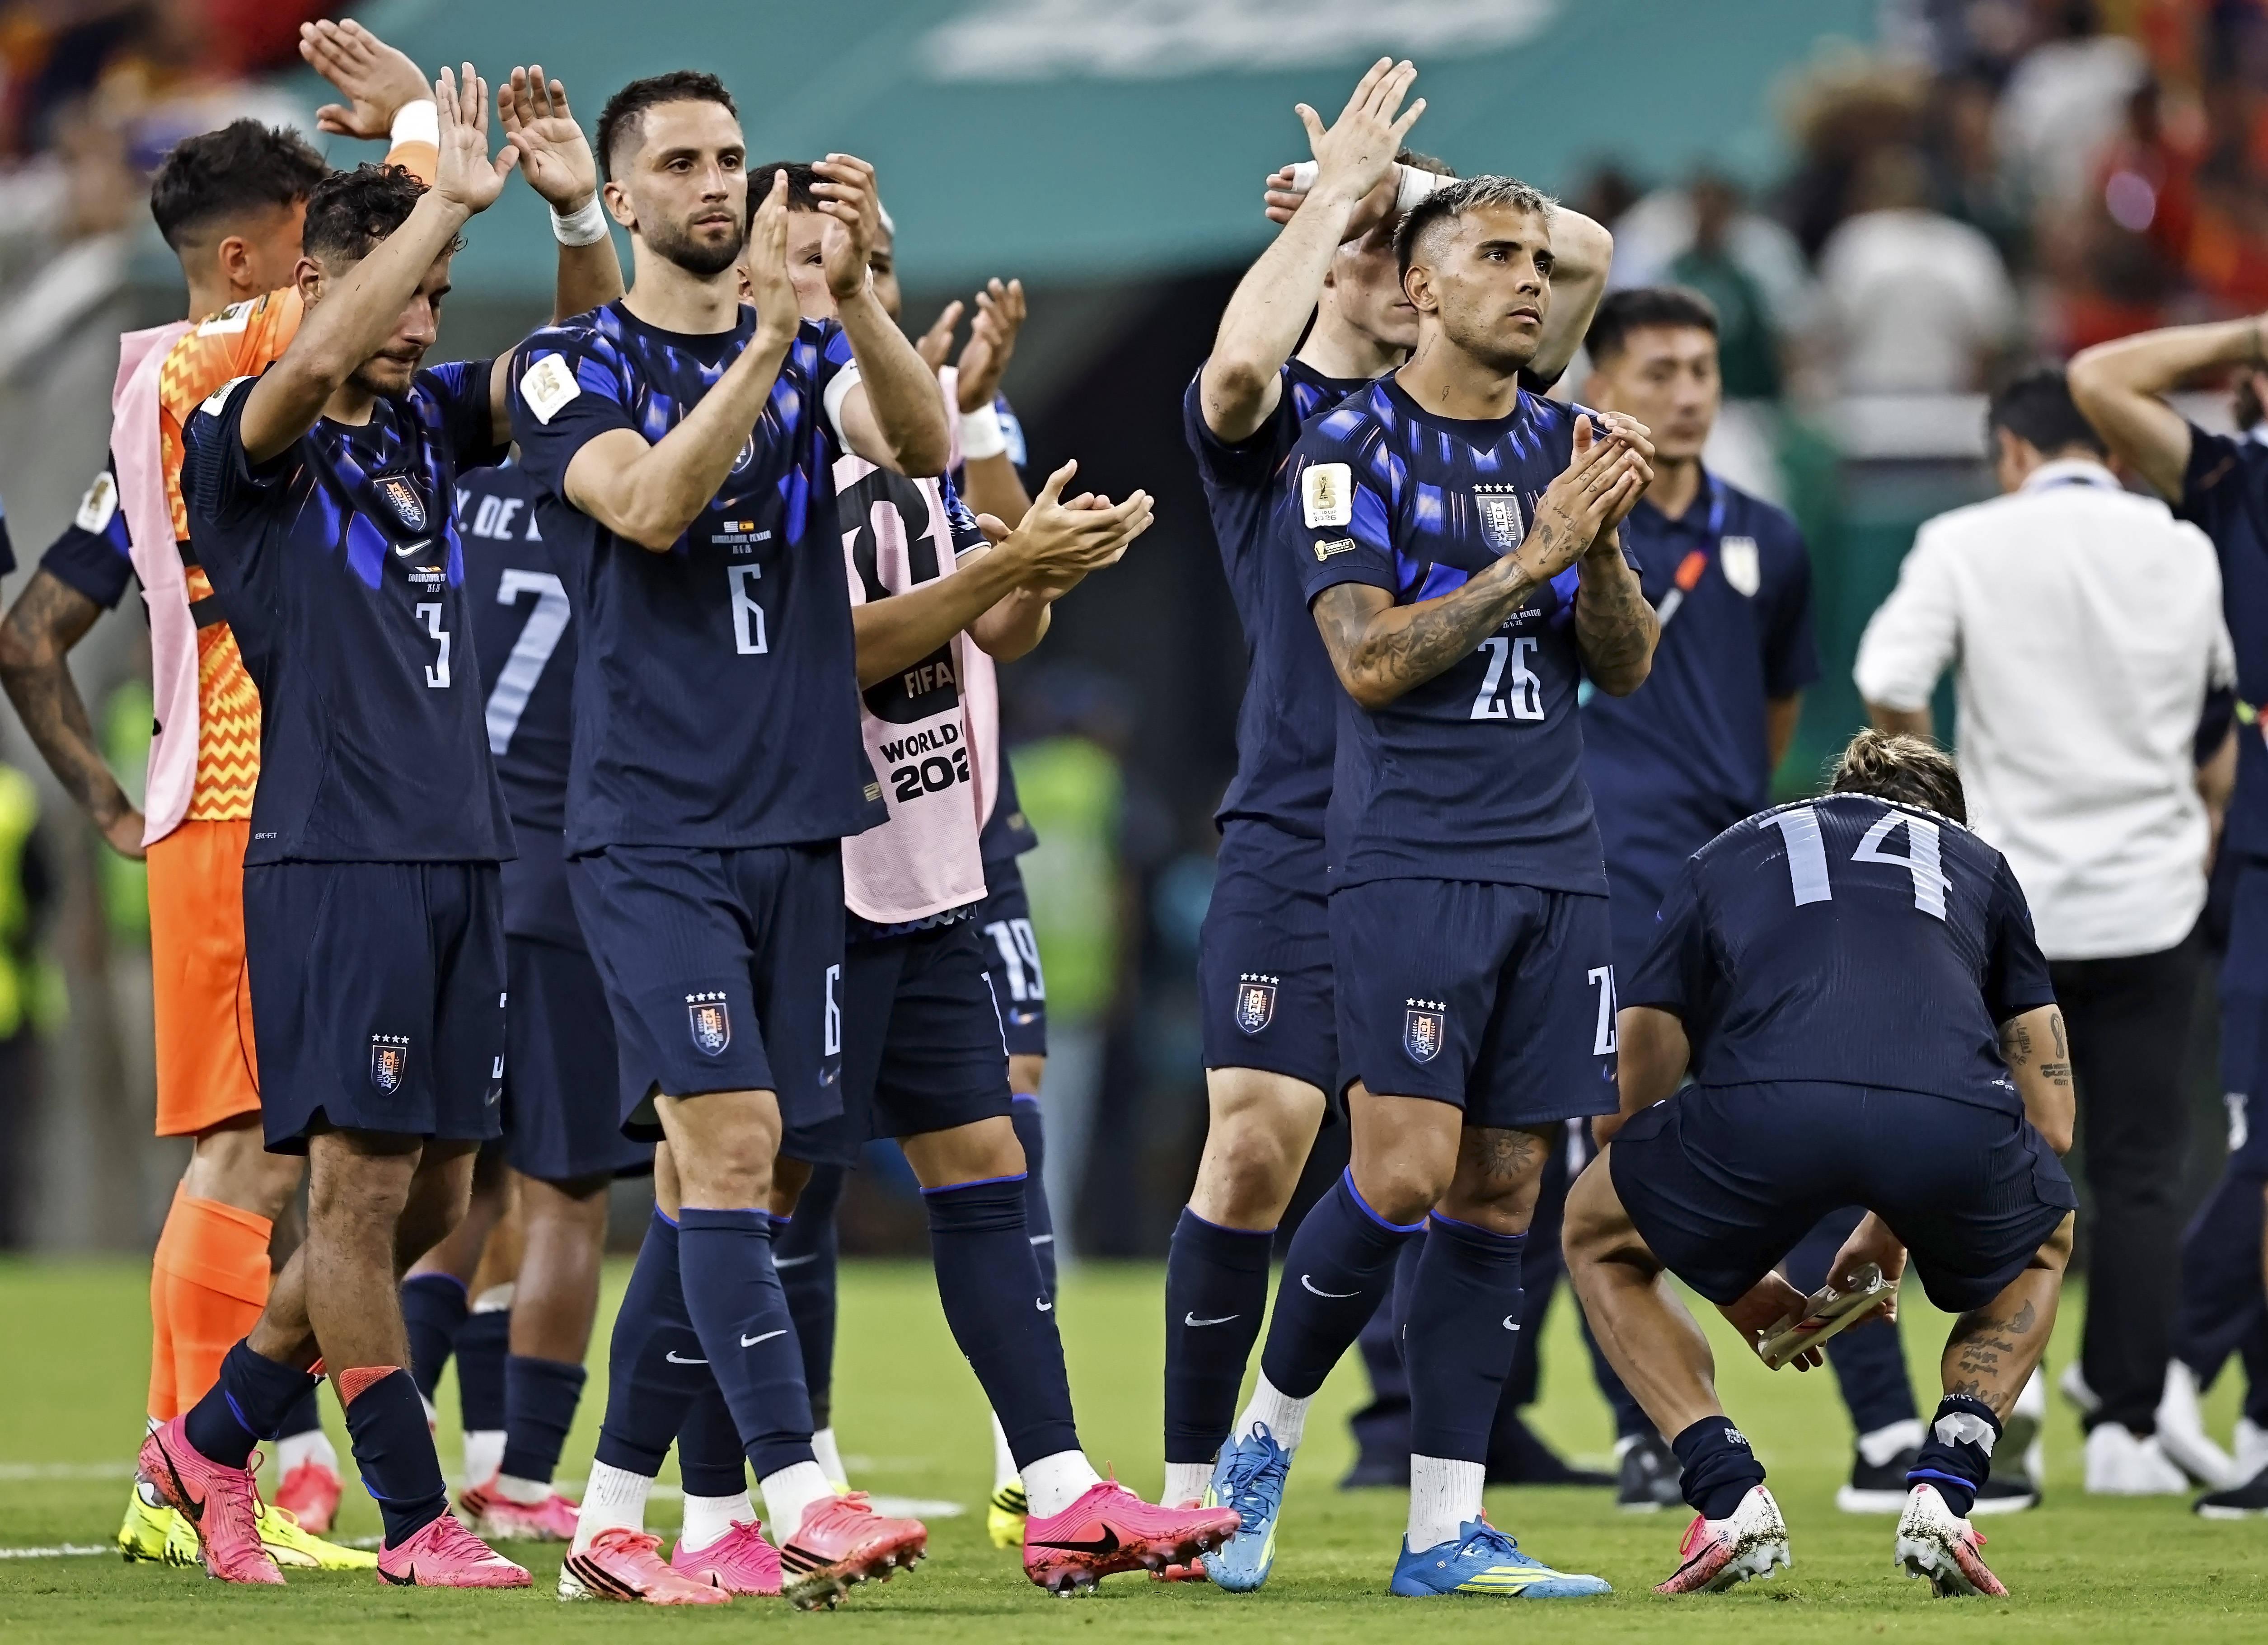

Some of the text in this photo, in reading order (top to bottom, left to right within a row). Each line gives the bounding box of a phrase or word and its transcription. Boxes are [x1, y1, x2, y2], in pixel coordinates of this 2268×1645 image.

[473, 495, 525, 541] DE
[1495, 507, 1505, 527] AUF
[416, 603, 450, 688] 3
[727, 564, 768, 654] 6
[484, 568, 571, 755] 7
[904, 662, 955, 698] FIFA
[1470, 637, 1545, 720] 26
[879, 724, 958, 763] WORLD
[1758, 806, 1953, 921] 14
[984, 918, 1046, 1001] 19
[825, 963, 840, 1056] 6
[1420, 1021, 1428, 1037] AUF
[1588, 963, 1618, 1055] 2
